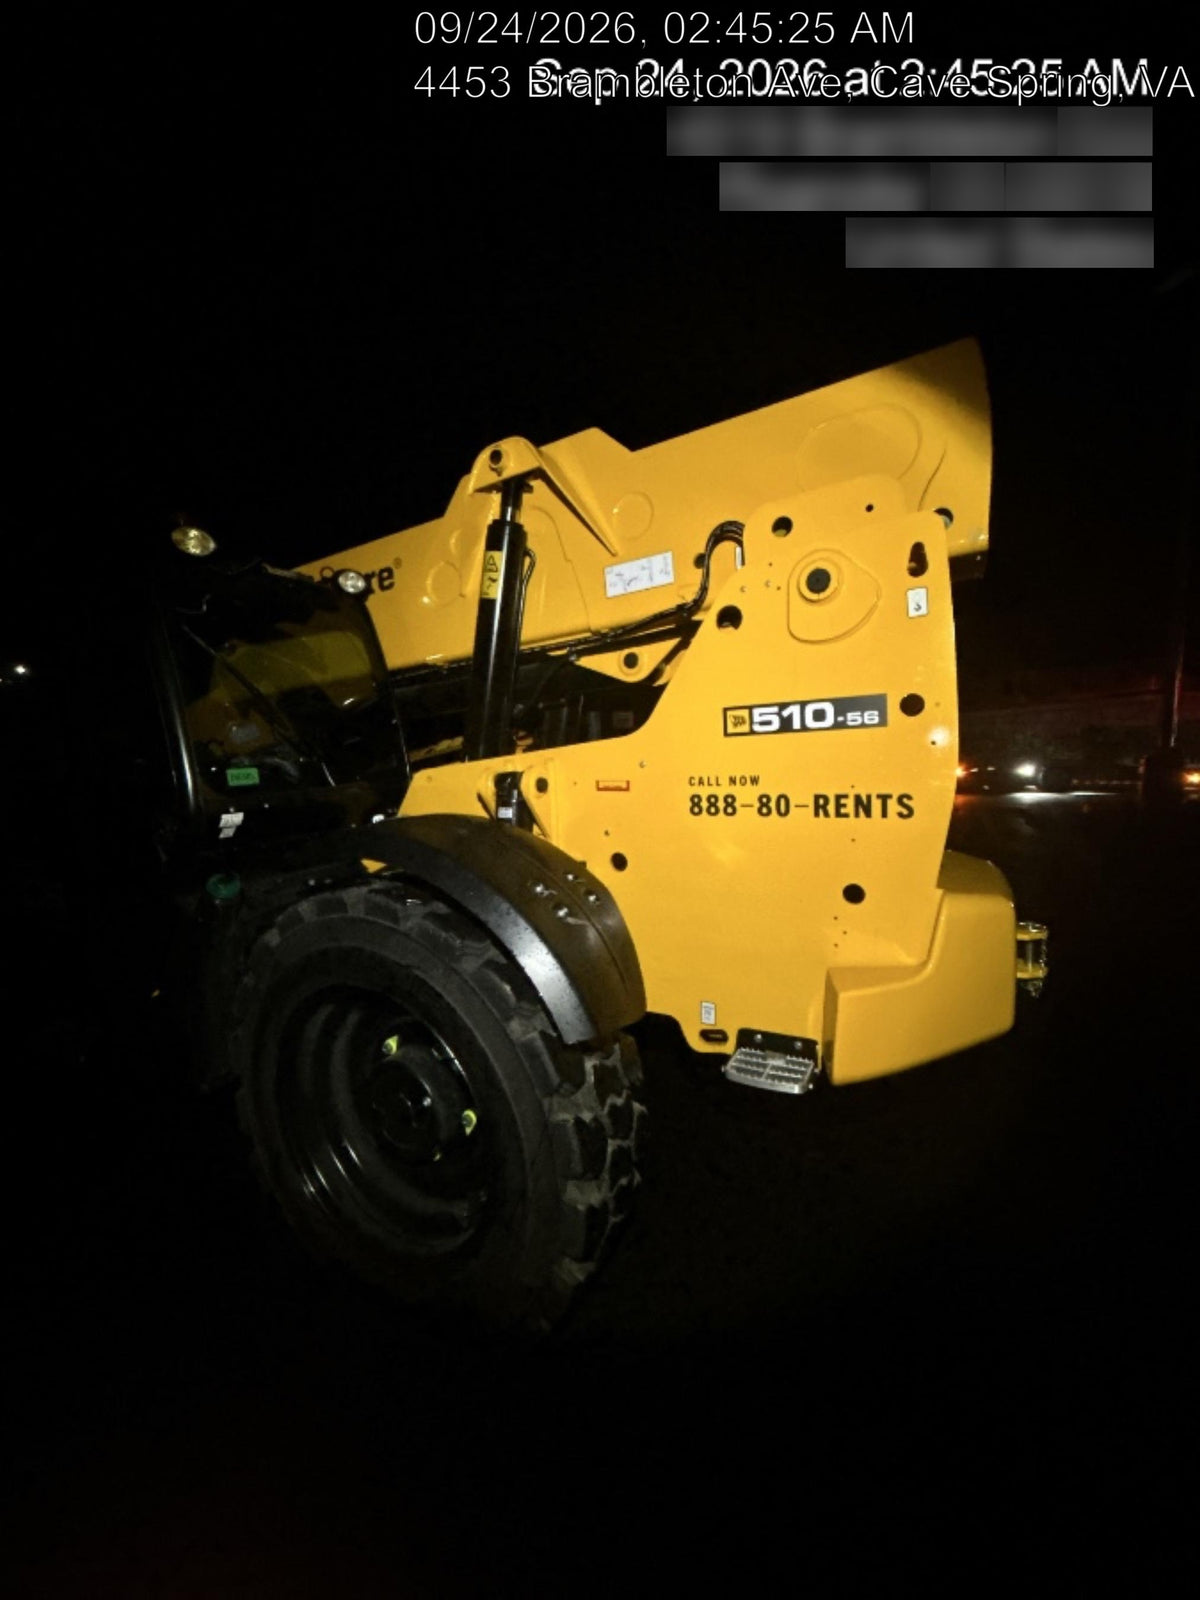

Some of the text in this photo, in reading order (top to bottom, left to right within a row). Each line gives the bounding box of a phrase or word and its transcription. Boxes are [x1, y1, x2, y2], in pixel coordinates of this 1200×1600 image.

[751, 701, 880, 733] 510-56
[688, 774, 761, 787] CALL NOW
[688, 793, 915, 819] 888-80-RENTS
